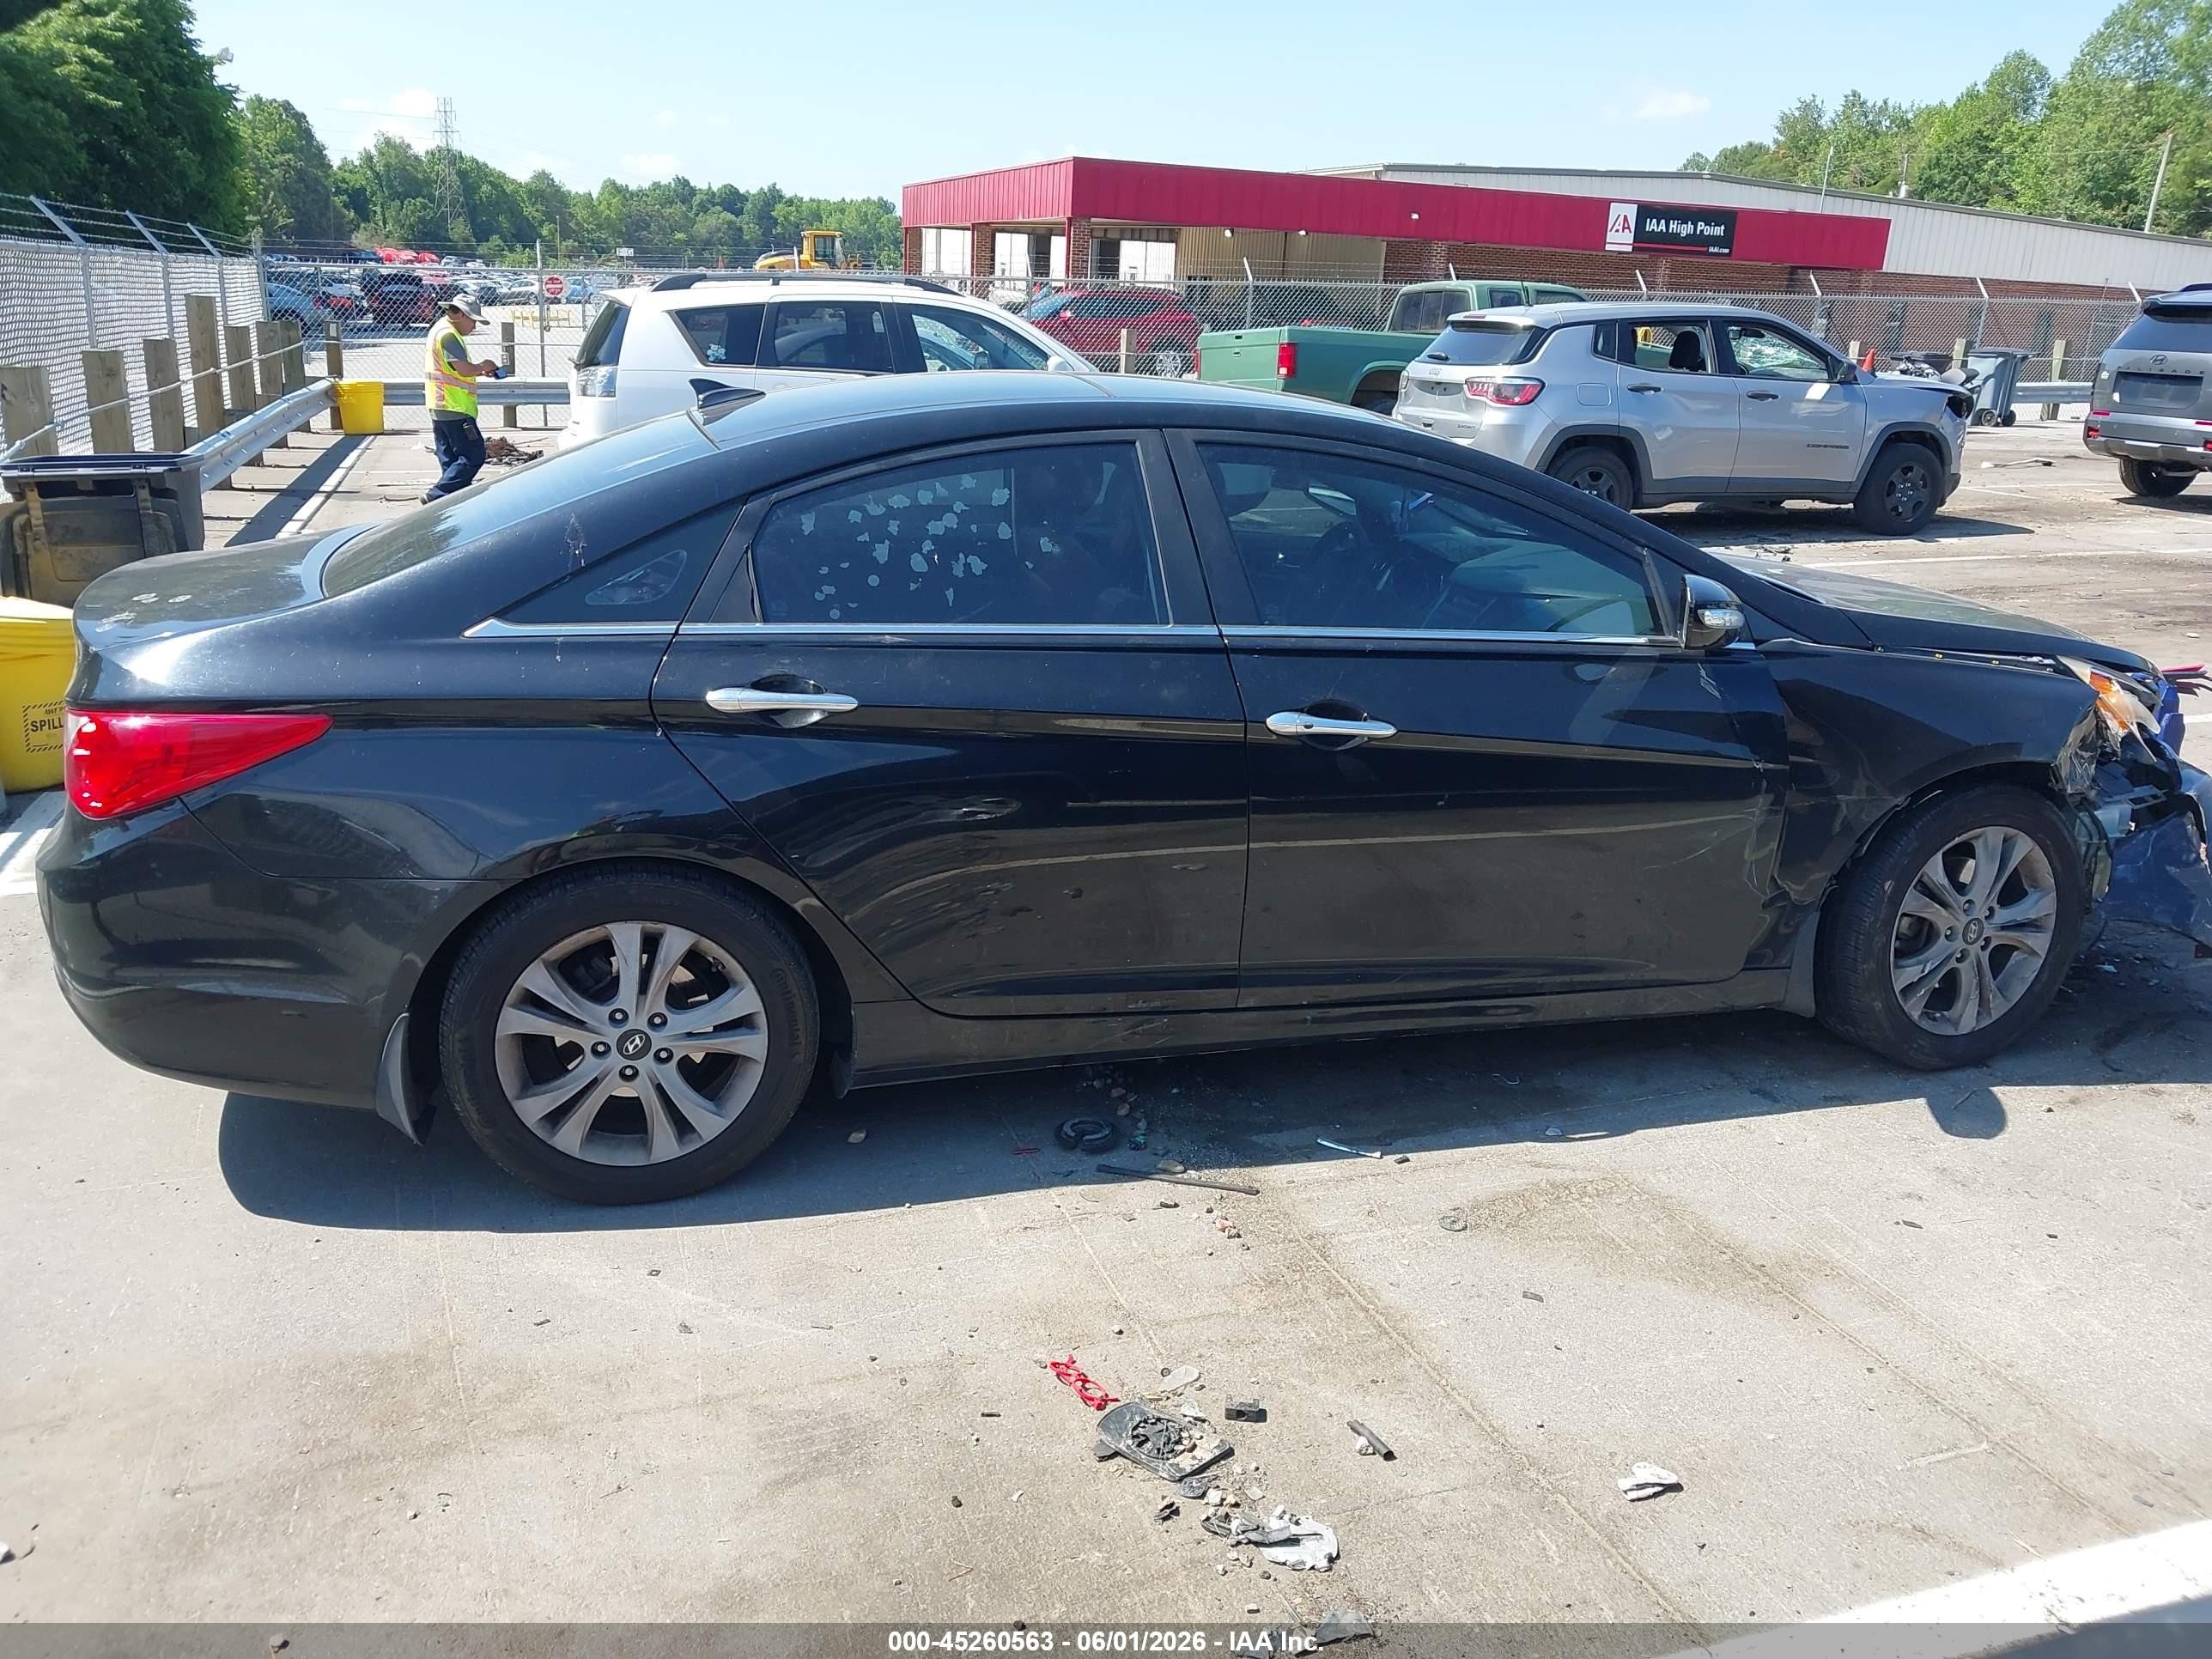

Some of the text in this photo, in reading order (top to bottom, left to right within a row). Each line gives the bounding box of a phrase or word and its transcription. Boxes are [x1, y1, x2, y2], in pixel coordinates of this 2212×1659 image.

[1645, 218, 1725, 237] IAA High Point
[30, 717, 64, 733] SPILL
